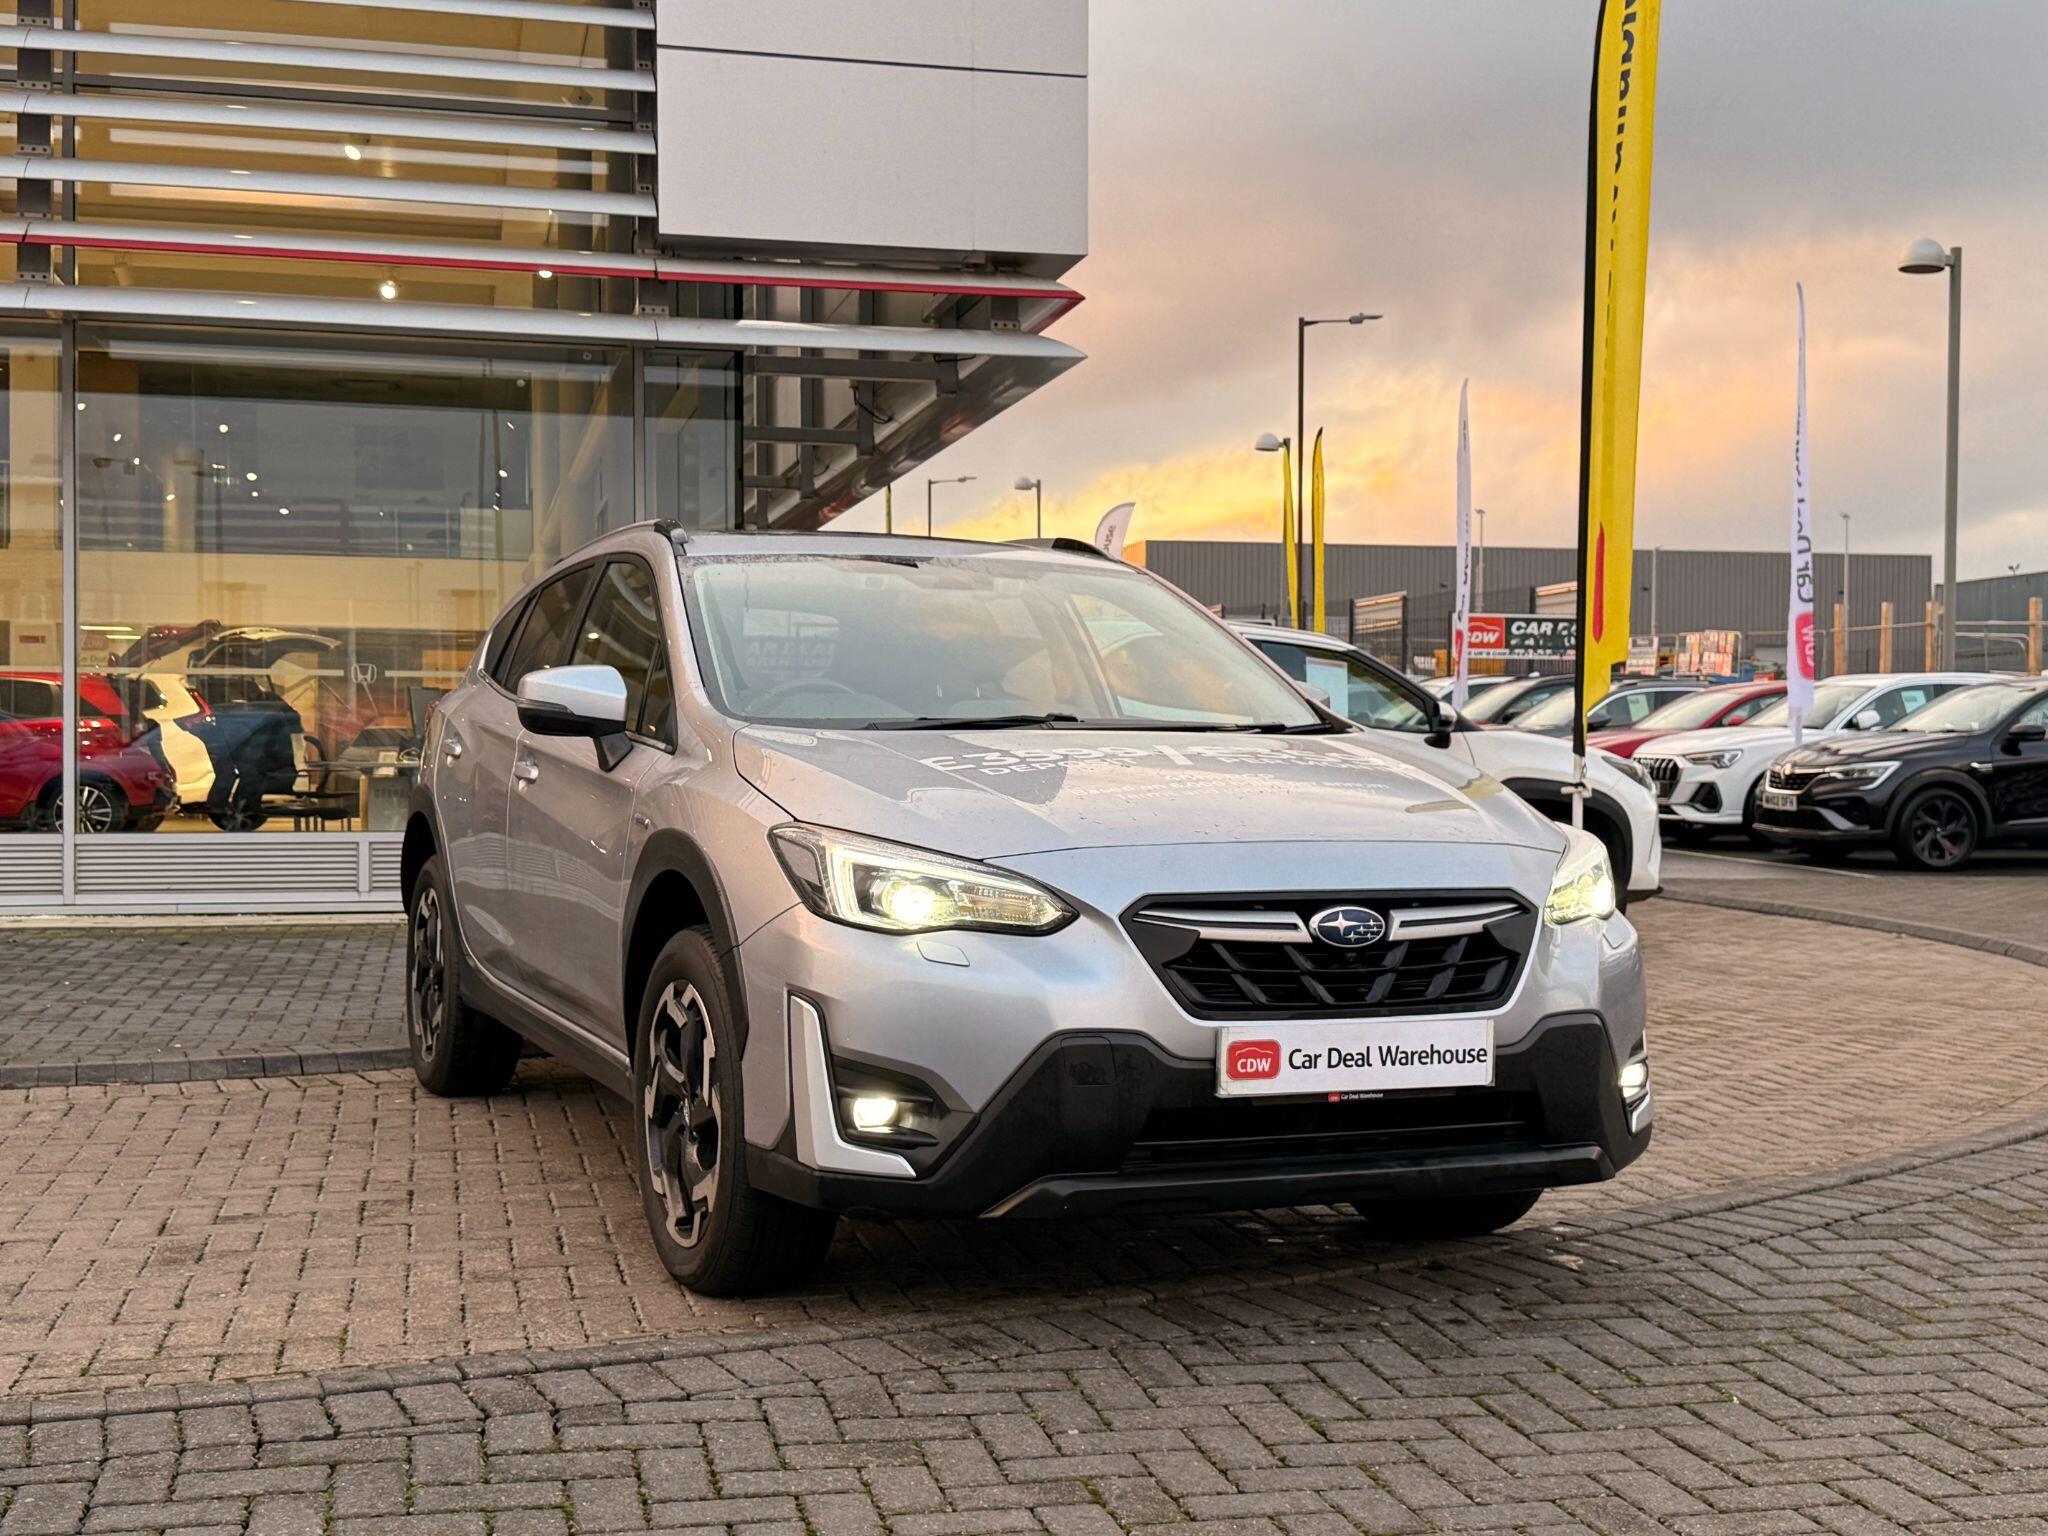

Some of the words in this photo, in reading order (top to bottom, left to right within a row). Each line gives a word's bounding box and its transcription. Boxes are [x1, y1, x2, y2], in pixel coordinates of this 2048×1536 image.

[1511, 621, 1553, 636] CAR
[1468, 631, 1500, 643] DW
[1236, 1058, 1272, 1073] CDW
[1288, 1049, 1322, 1069] Car
[1326, 1046, 1373, 1068] Deal
[1378, 1044, 1488, 1067] Warehouse
